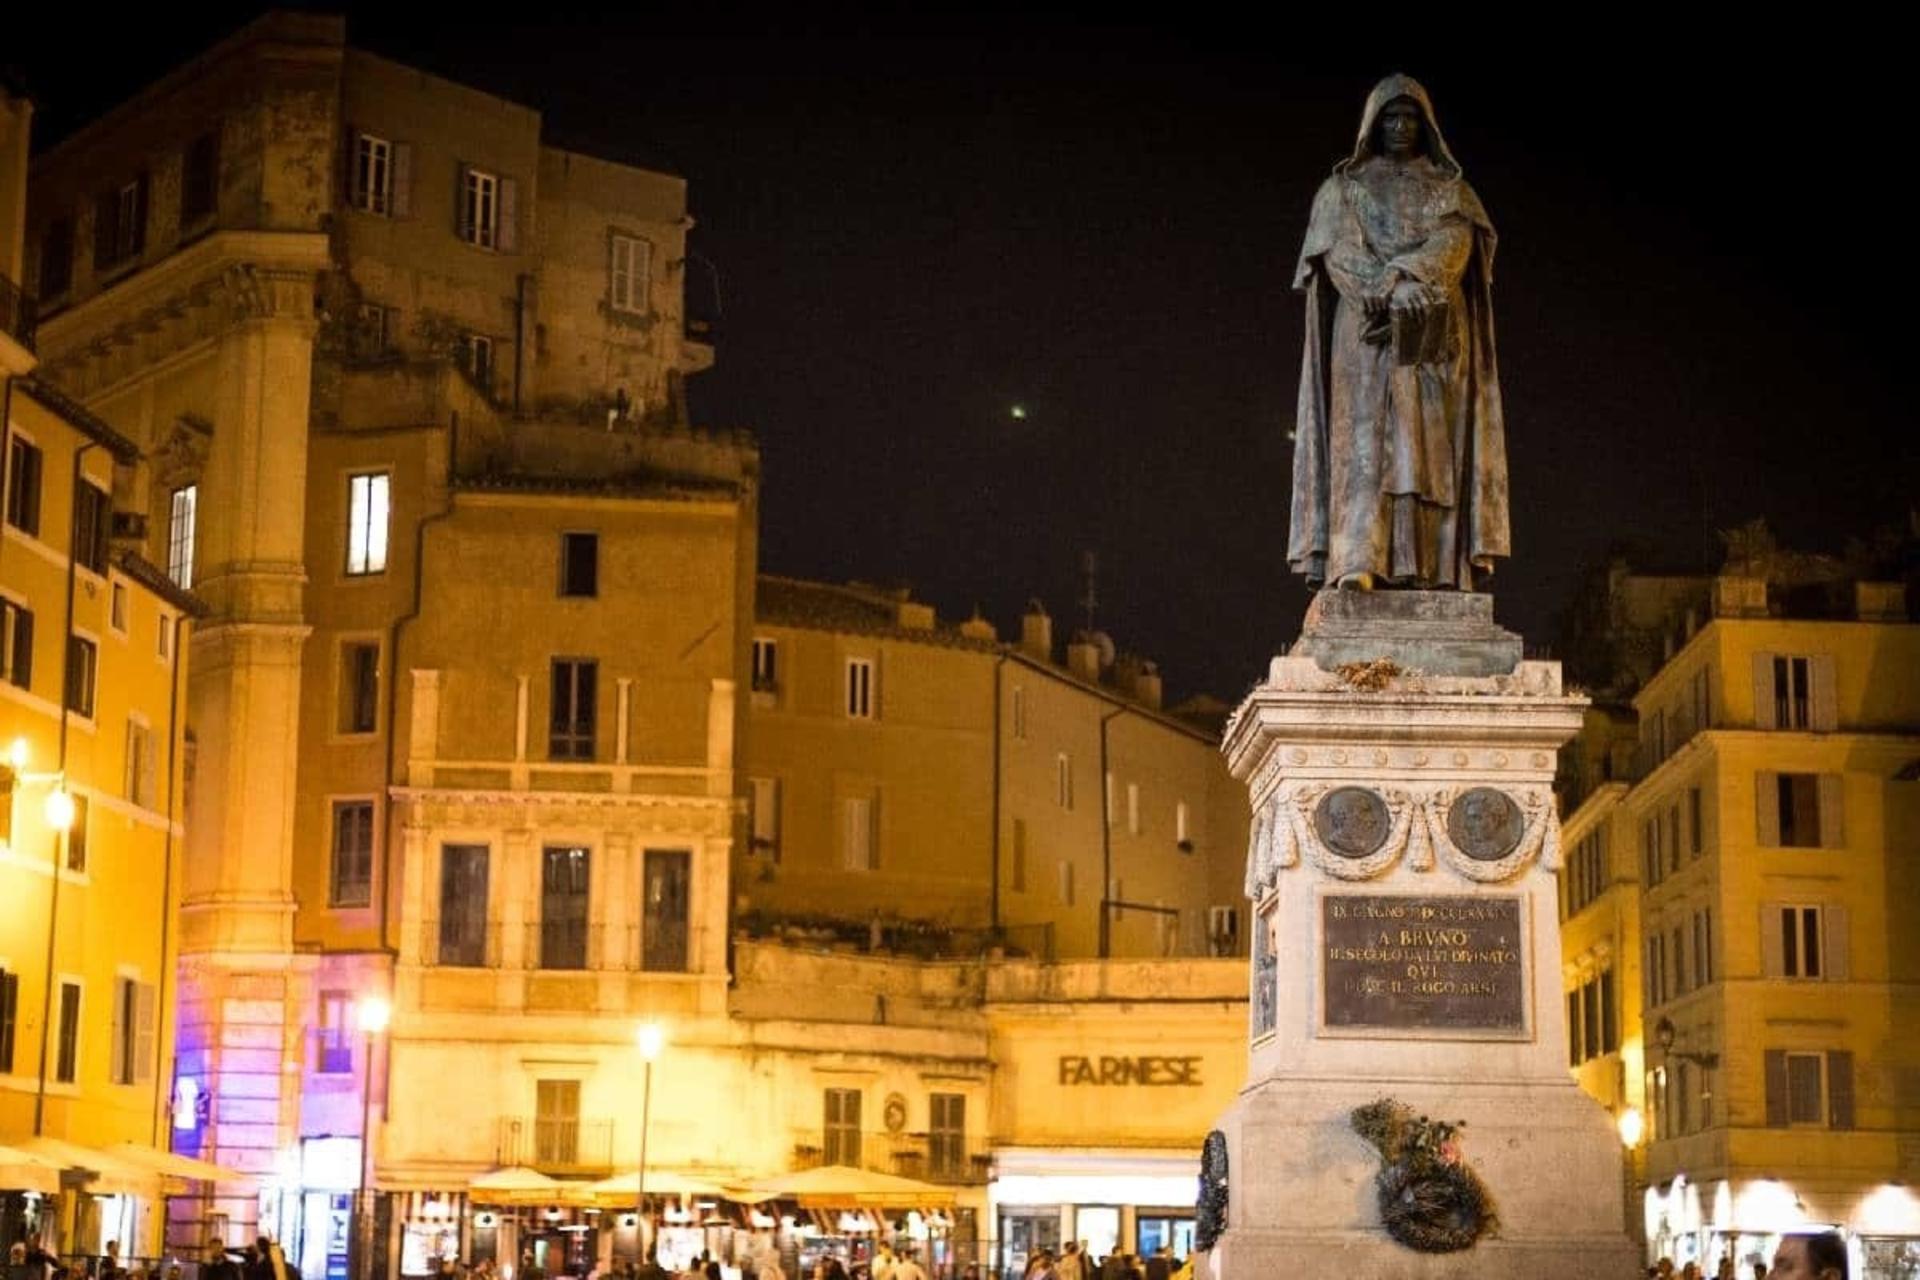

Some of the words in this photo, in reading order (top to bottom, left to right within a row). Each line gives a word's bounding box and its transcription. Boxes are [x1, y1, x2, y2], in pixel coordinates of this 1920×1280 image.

[1379, 930, 1391, 945] A
[1400, 930, 1468, 946] BRVNO
[1345, 948, 1402, 961] SECOLO
[1407, 964, 1437, 980] QVI
[1059, 1056, 1204, 1086] FARNESE
